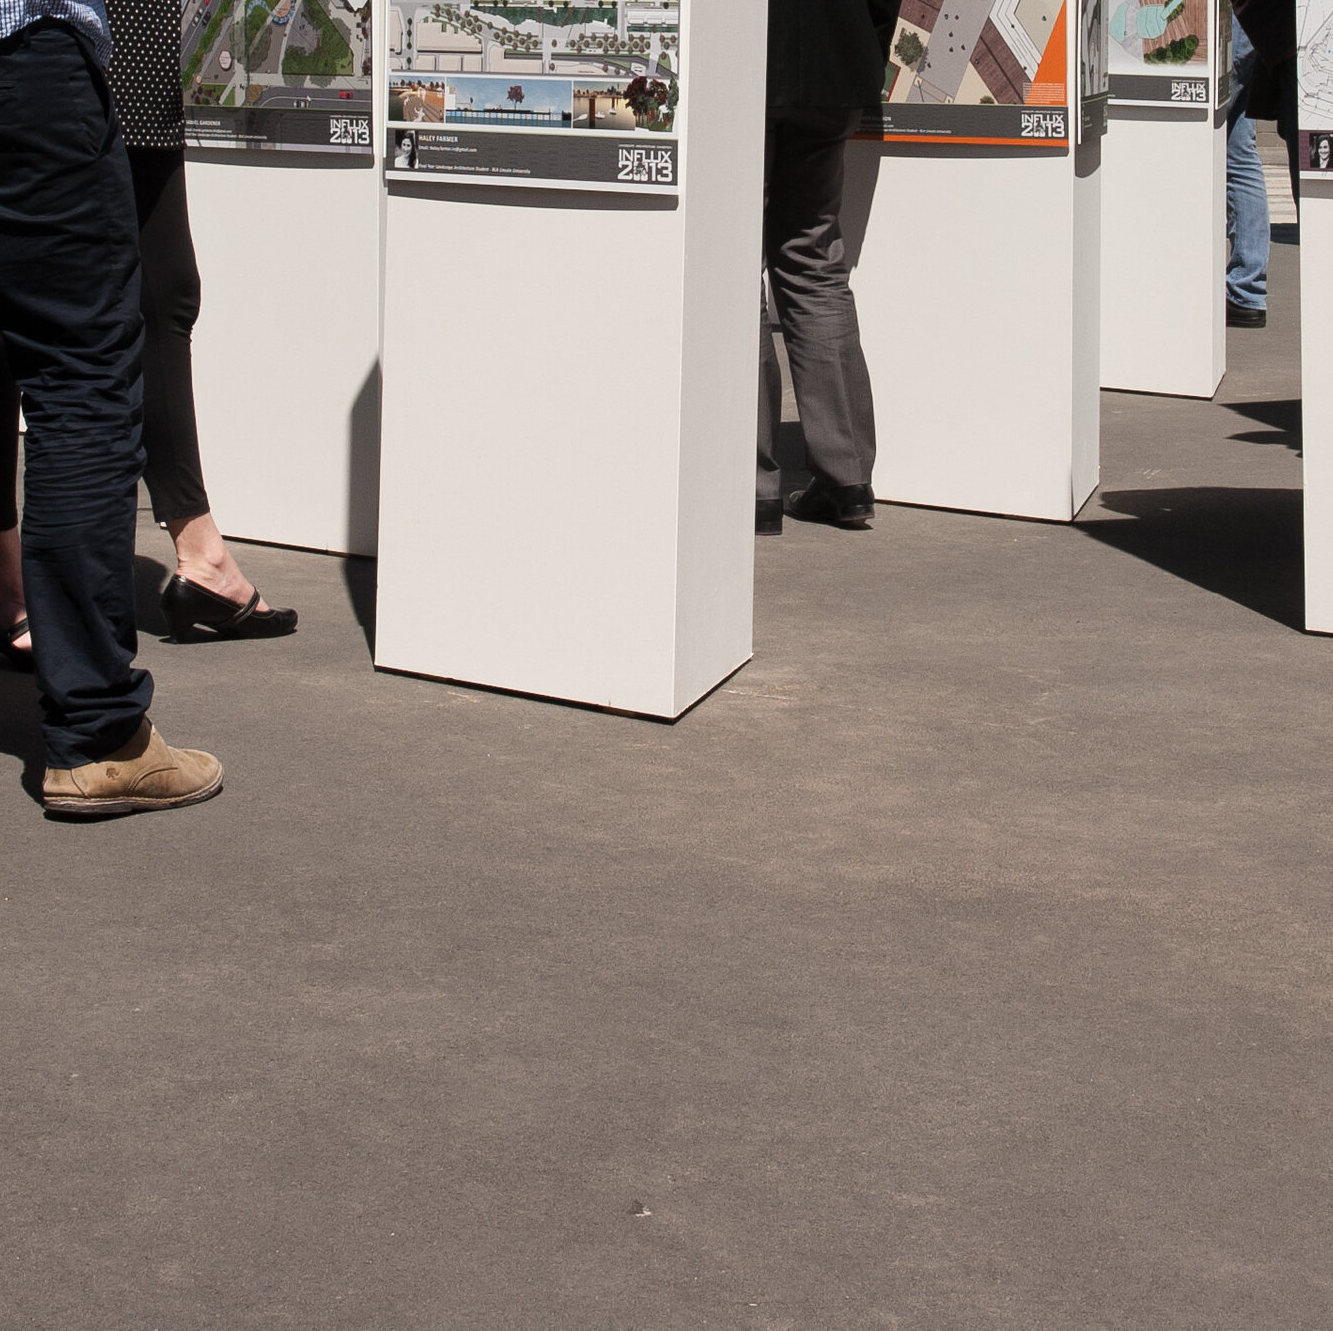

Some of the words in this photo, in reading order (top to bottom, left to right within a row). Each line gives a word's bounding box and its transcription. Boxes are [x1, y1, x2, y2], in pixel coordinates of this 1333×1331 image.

[1171, 82, 1205, 91] INFLUX
[1170, 89, 1207, 102] 2013
[329, 119, 369, 130] INFLUX
[1021, 114, 1064, 124] INFLUX
[329, 128, 370, 144] 2013
[1021, 123, 1065, 138] 2013
[419, 134, 436, 142] HALEY
[618, 149, 672, 163] INFLUX
[617, 160, 673, 182] 2013
